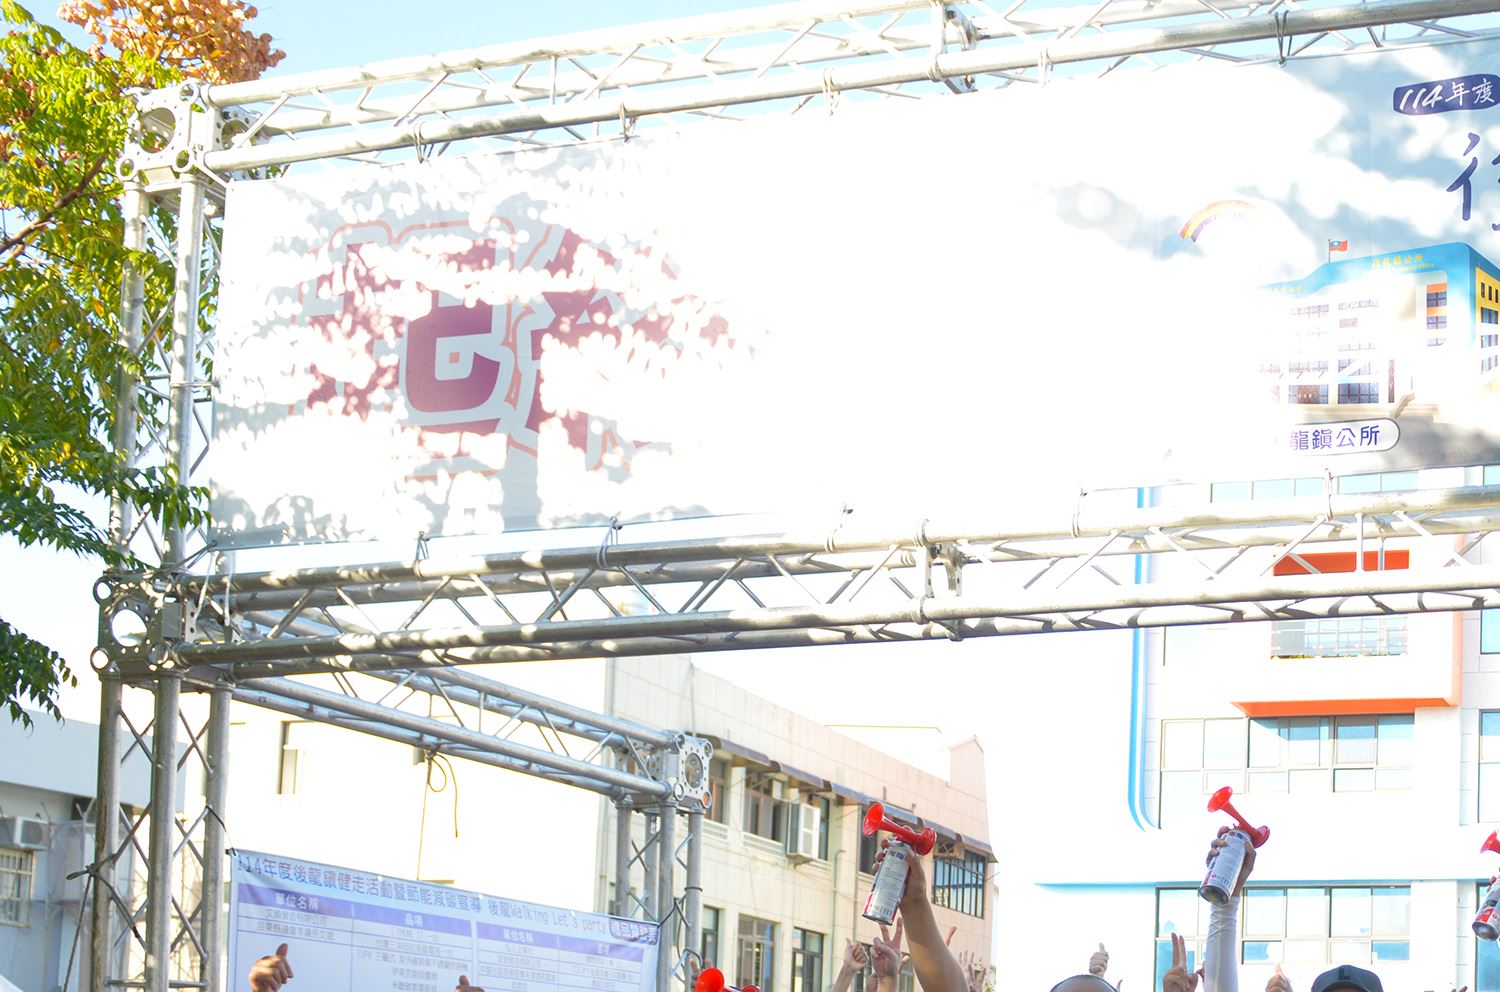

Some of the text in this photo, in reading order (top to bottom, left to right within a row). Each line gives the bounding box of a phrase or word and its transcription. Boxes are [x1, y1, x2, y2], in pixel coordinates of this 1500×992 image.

[1397, 81, 1497, 112] 114年度
[1278, 425, 1381, 452] 龍鎮公所
